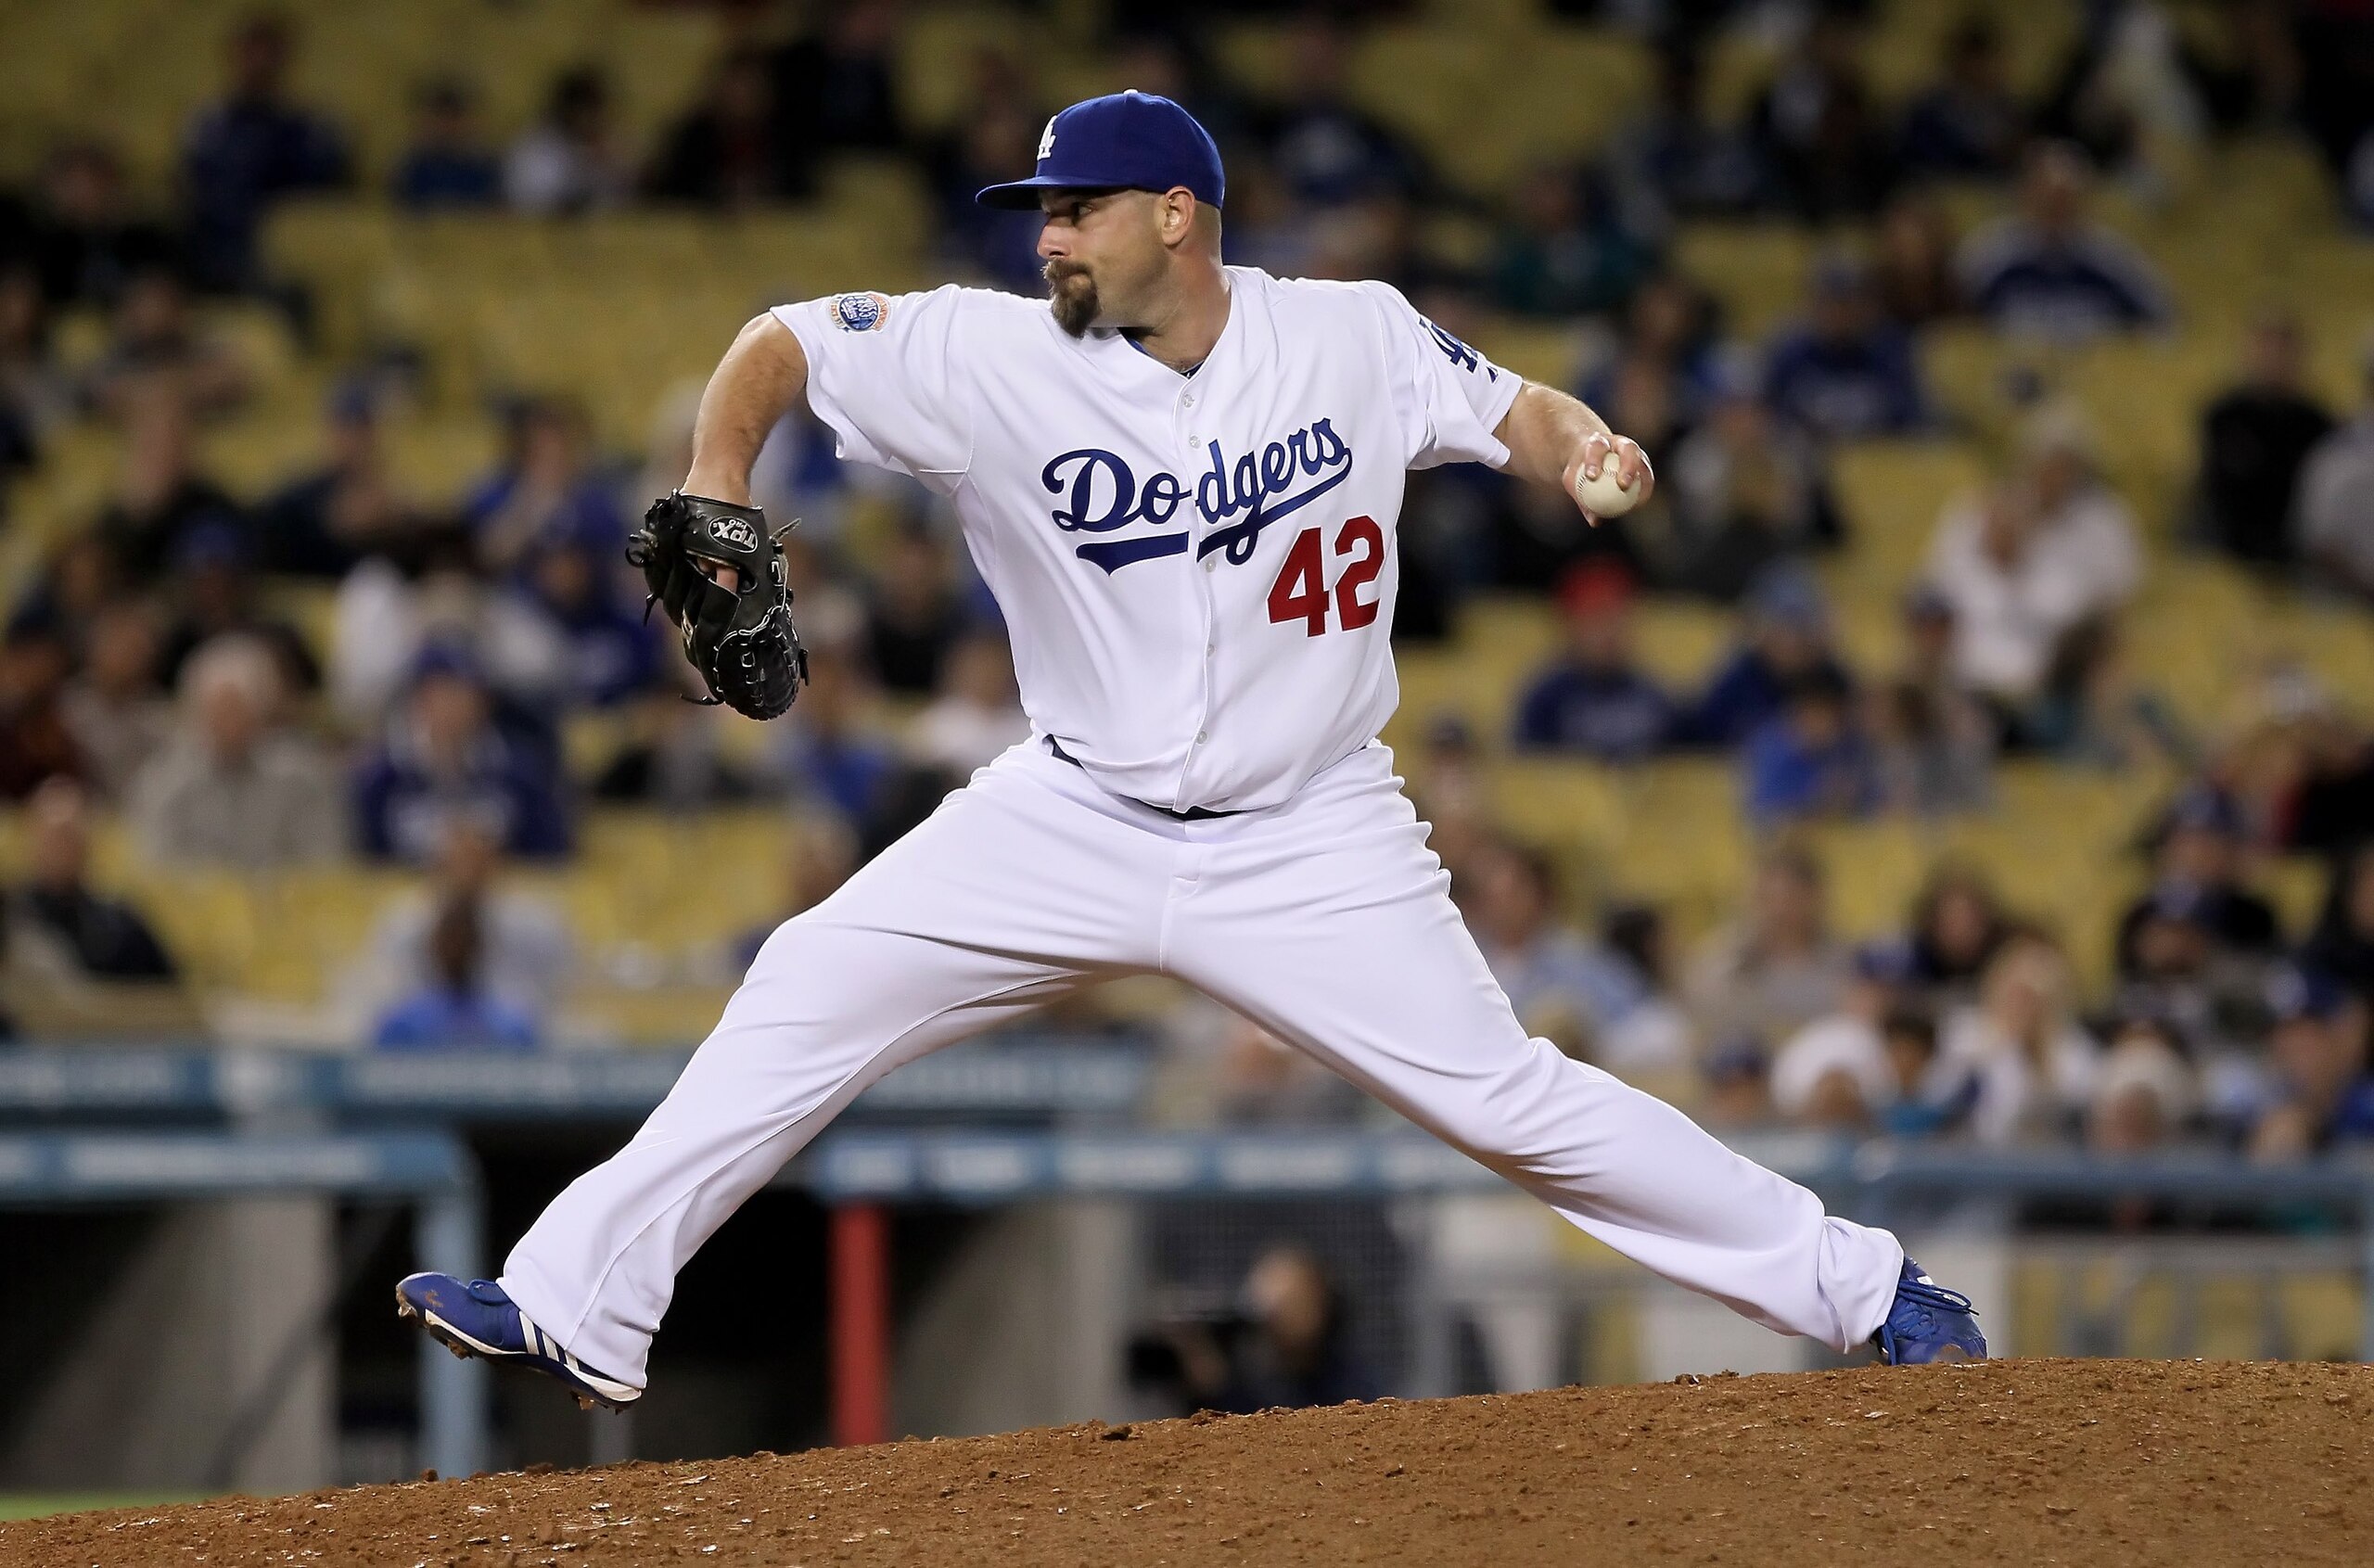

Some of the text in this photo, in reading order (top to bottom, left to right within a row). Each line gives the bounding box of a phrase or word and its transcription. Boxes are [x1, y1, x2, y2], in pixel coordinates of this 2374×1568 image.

[713, 521, 755, 549] TPX
[1041, 417, 1353, 567] Dodgers
[1267, 516, 1385, 637] 42
